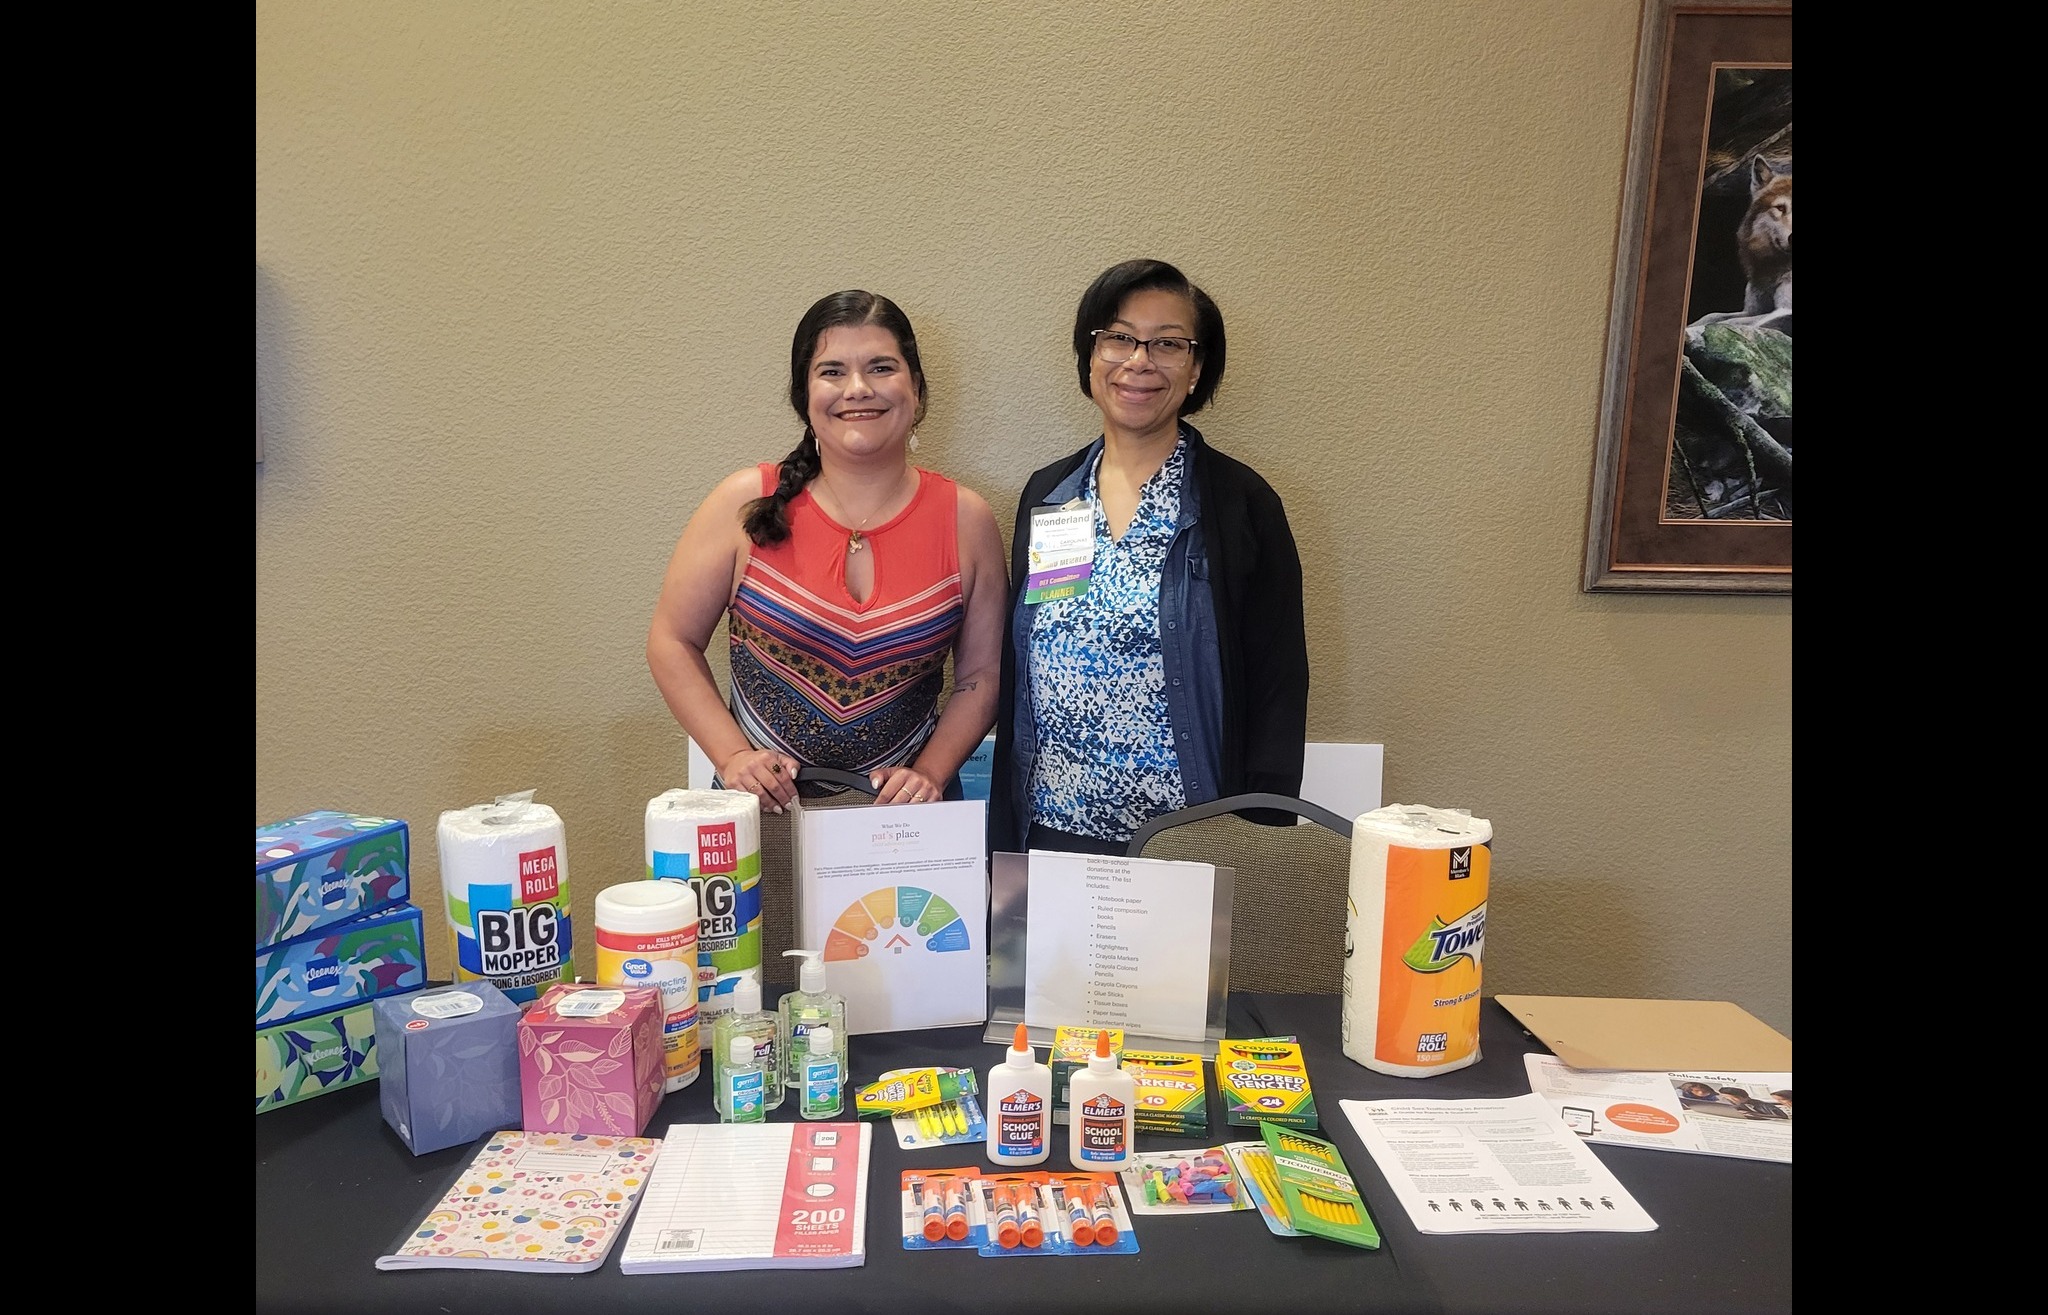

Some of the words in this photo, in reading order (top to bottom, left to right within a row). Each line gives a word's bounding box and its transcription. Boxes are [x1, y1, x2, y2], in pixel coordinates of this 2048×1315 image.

[1034, 514, 1090, 527] Wonderland
[1050, 574, 1080, 584] Committee
[1040, 586, 1075, 600] PLANNER
[700, 831, 733, 848] MEGA
[872, 831, 894, 842] pat's
[896, 830, 920, 841] place
[702, 850, 734, 866] ROLL
[1087, 858, 1130, 866] back-to-school
[522, 856, 555, 875] MEGA
[1087, 866, 1114, 874] donations
[319, 877, 350, 897] Kleenex
[525, 876, 555, 895] ROLL
[1086, 882, 1111, 890] includes:
[1098, 895, 1125, 903] Notebook
[1114, 907, 1148, 915] composition
[482, 906, 556, 953] BIG
[1096, 923, 1117, 931] Pencils
[656, 936, 670, 944] KILLS
[1431, 920, 1485, 961] Towe
[647, 942, 675, 950] BACTERIA
[1096, 943, 1129, 952] Highlighters
[485, 944, 558, 972] MOPPER
[1096, 953, 1116, 961] Crayola
[625, 962, 647, 972] Great
[1116, 964, 1138, 972] Colored
[302, 962, 344, 984] Kleenex
[488, 976, 513, 990] TRONG
[514, 976, 520, 988] &
[521, 968, 562, 987] ABSORBENT
[638, 976, 687, 988] Disinfecting
[1094, 980, 1115, 988] Crayola
[1116, 982, 1138, 990] Crayons
[1434, 998, 1457, 1007] Strong
[1458, 994, 1464, 1003] &
[1110, 1010, 1127, 1018] towels
[1092, 1019, 1125, 1027] Disinfectant
[1420, 1033, 1447, 1043] MEGA
[754, 1044, 771, 1056] rell
[1234, 1044, 1287, 1052] Crayola
[1418, 1042, 1446, 1052] ROLL
[307, 1044, 348, 1065] Kleenex
[1124, 1053, 1185, 1061] Crayola
[1416, 1054, 1431, 1062] 150
[1228, 1073, 1305, 1085] COLORED
[1668, 1072, 1702, 1080] Online
[1134, 1078, 1197, 1091] ARKERS
[1234, 1080, 1303, 1092] PENCILS
[1002, 1102, 1041, 1112] ELMER'S
[1262, 1098, 1282, 1107] 24
[1084, 1106, 1124, 1116] ELMER'S
[1003, 1122, 1040, 1132] SCHOOL
[1085, 1127, 1122, 1137] SCHOOL
[904, 1136, 916, 1144] 4
[1010, 1132, 1033, 1140] GLUE
[1091, 1136, 1116, 1145] GLUE
[1280, 1158, 1348, 1181] TICONDEROGA
[791, 1208, 846, 1225] 200
[796, 1223, 839, 1231] SHEETS
